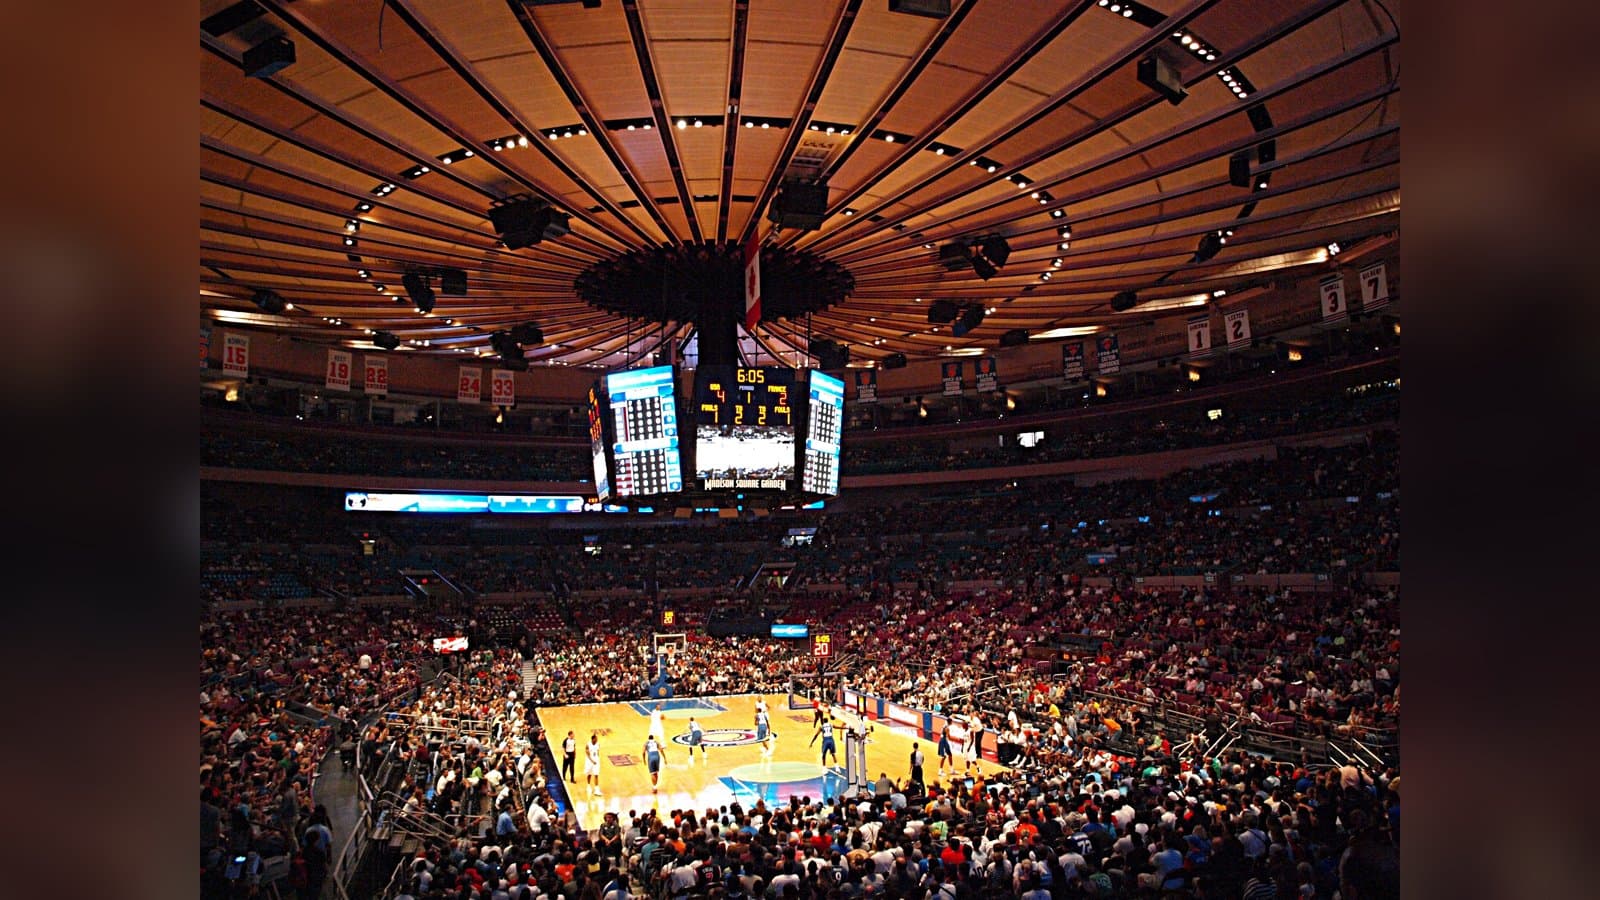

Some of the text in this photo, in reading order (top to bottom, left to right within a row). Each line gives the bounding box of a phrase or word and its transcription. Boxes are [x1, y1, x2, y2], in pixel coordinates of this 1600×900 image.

[1367, 277, 1379, 299] 7
[1327, 291, 1339, 312] 3
[1232, 320, 1244, 339] 2
[1196, 330, 1203, 348] 1
[329, 361, 349, 379] 19
[366, 367, 387, 384] 22
[737, 369, 765, 383] 6:05
[494, 379, 513, 396] 33
[717, 391, 725, 403] 4
[779, 393, 787, 405] 2
[814, 643, 828, 656] 20
